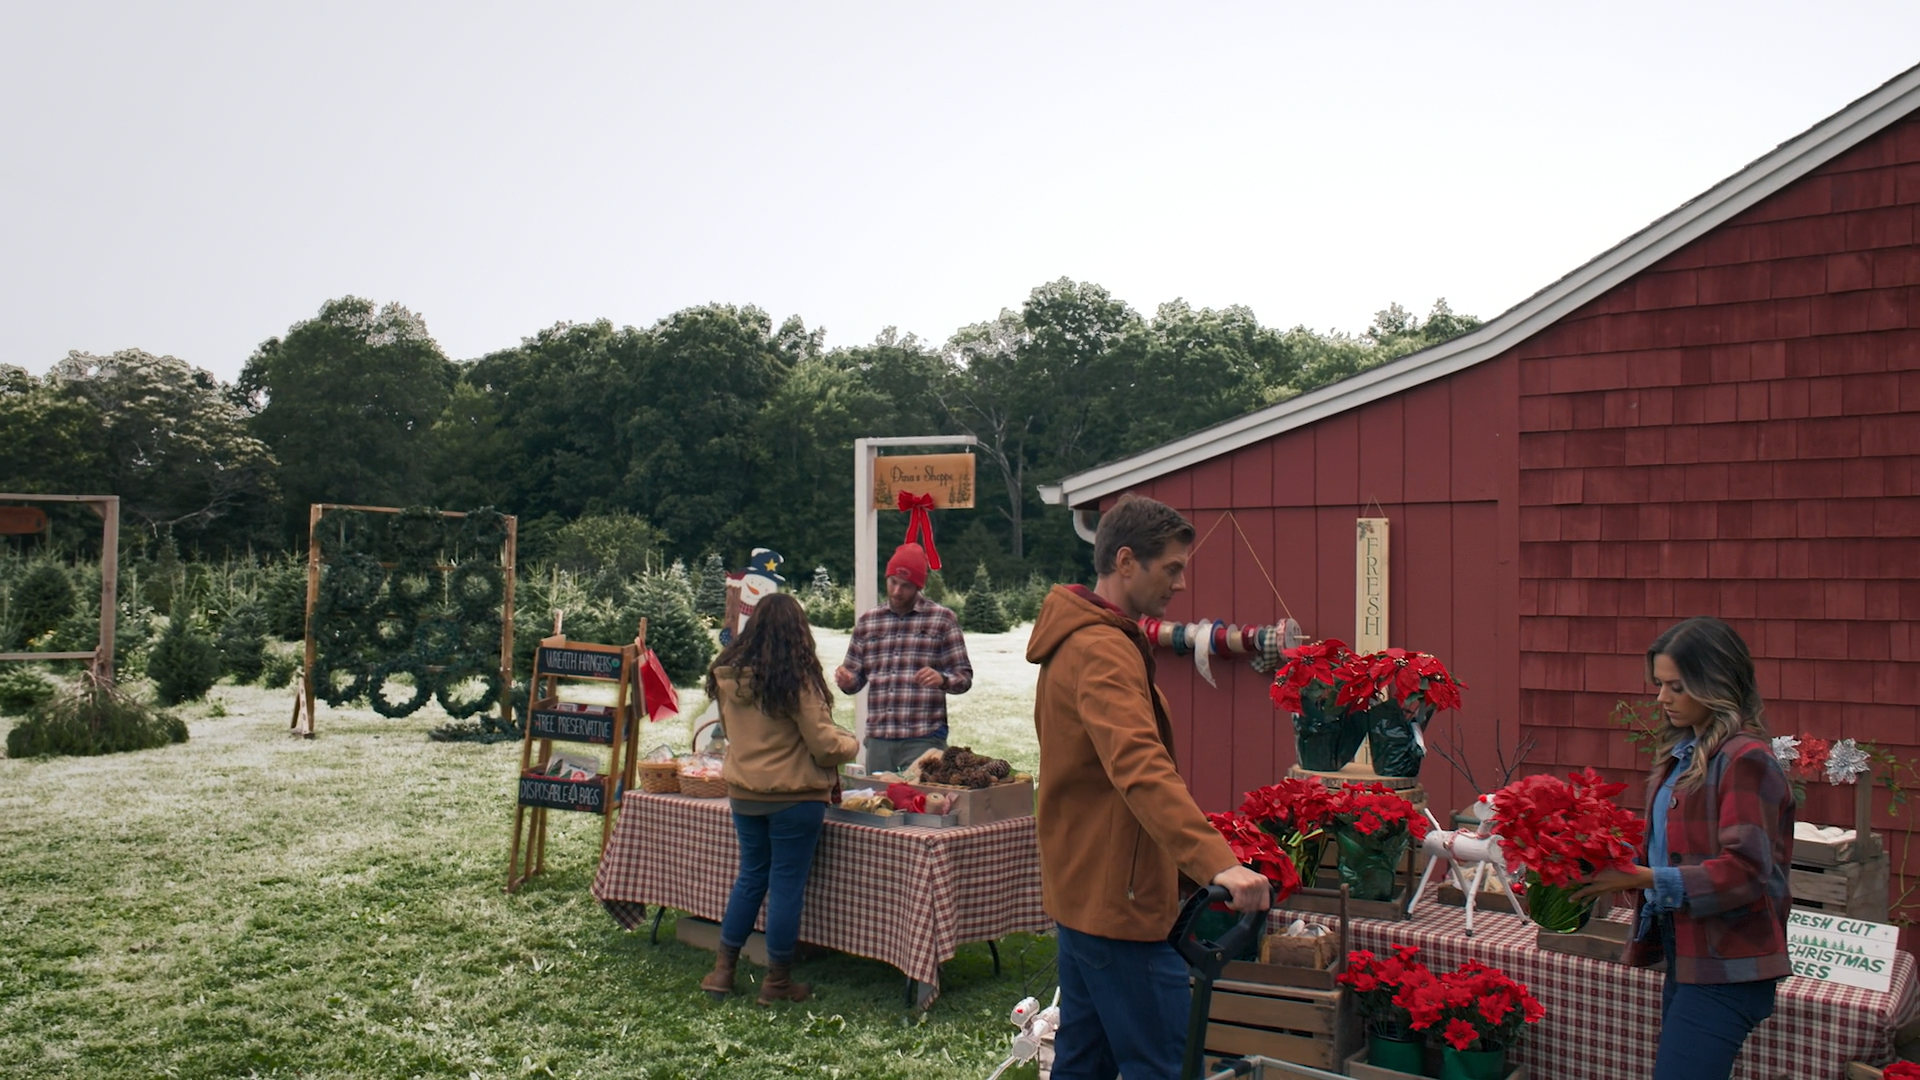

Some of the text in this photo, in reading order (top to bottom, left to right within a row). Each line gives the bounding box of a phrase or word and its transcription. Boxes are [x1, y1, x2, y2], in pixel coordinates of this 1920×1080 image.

[924, 465, 953, 486] Shoppe
[1364, 537, 1380, 636] FRESH
[546, 650, 612, 673] WREATH HANGERS
[536, 714, 611, 738] TREE PRESERVATIVE
[520, 780, 600, 806] DISPOSABLE BAGS
[1837, 920, 1877, 937] CUT
[1787, 943, 1886, 973] CHRISTMAS
[1790, 960, 1832, 979] EES
